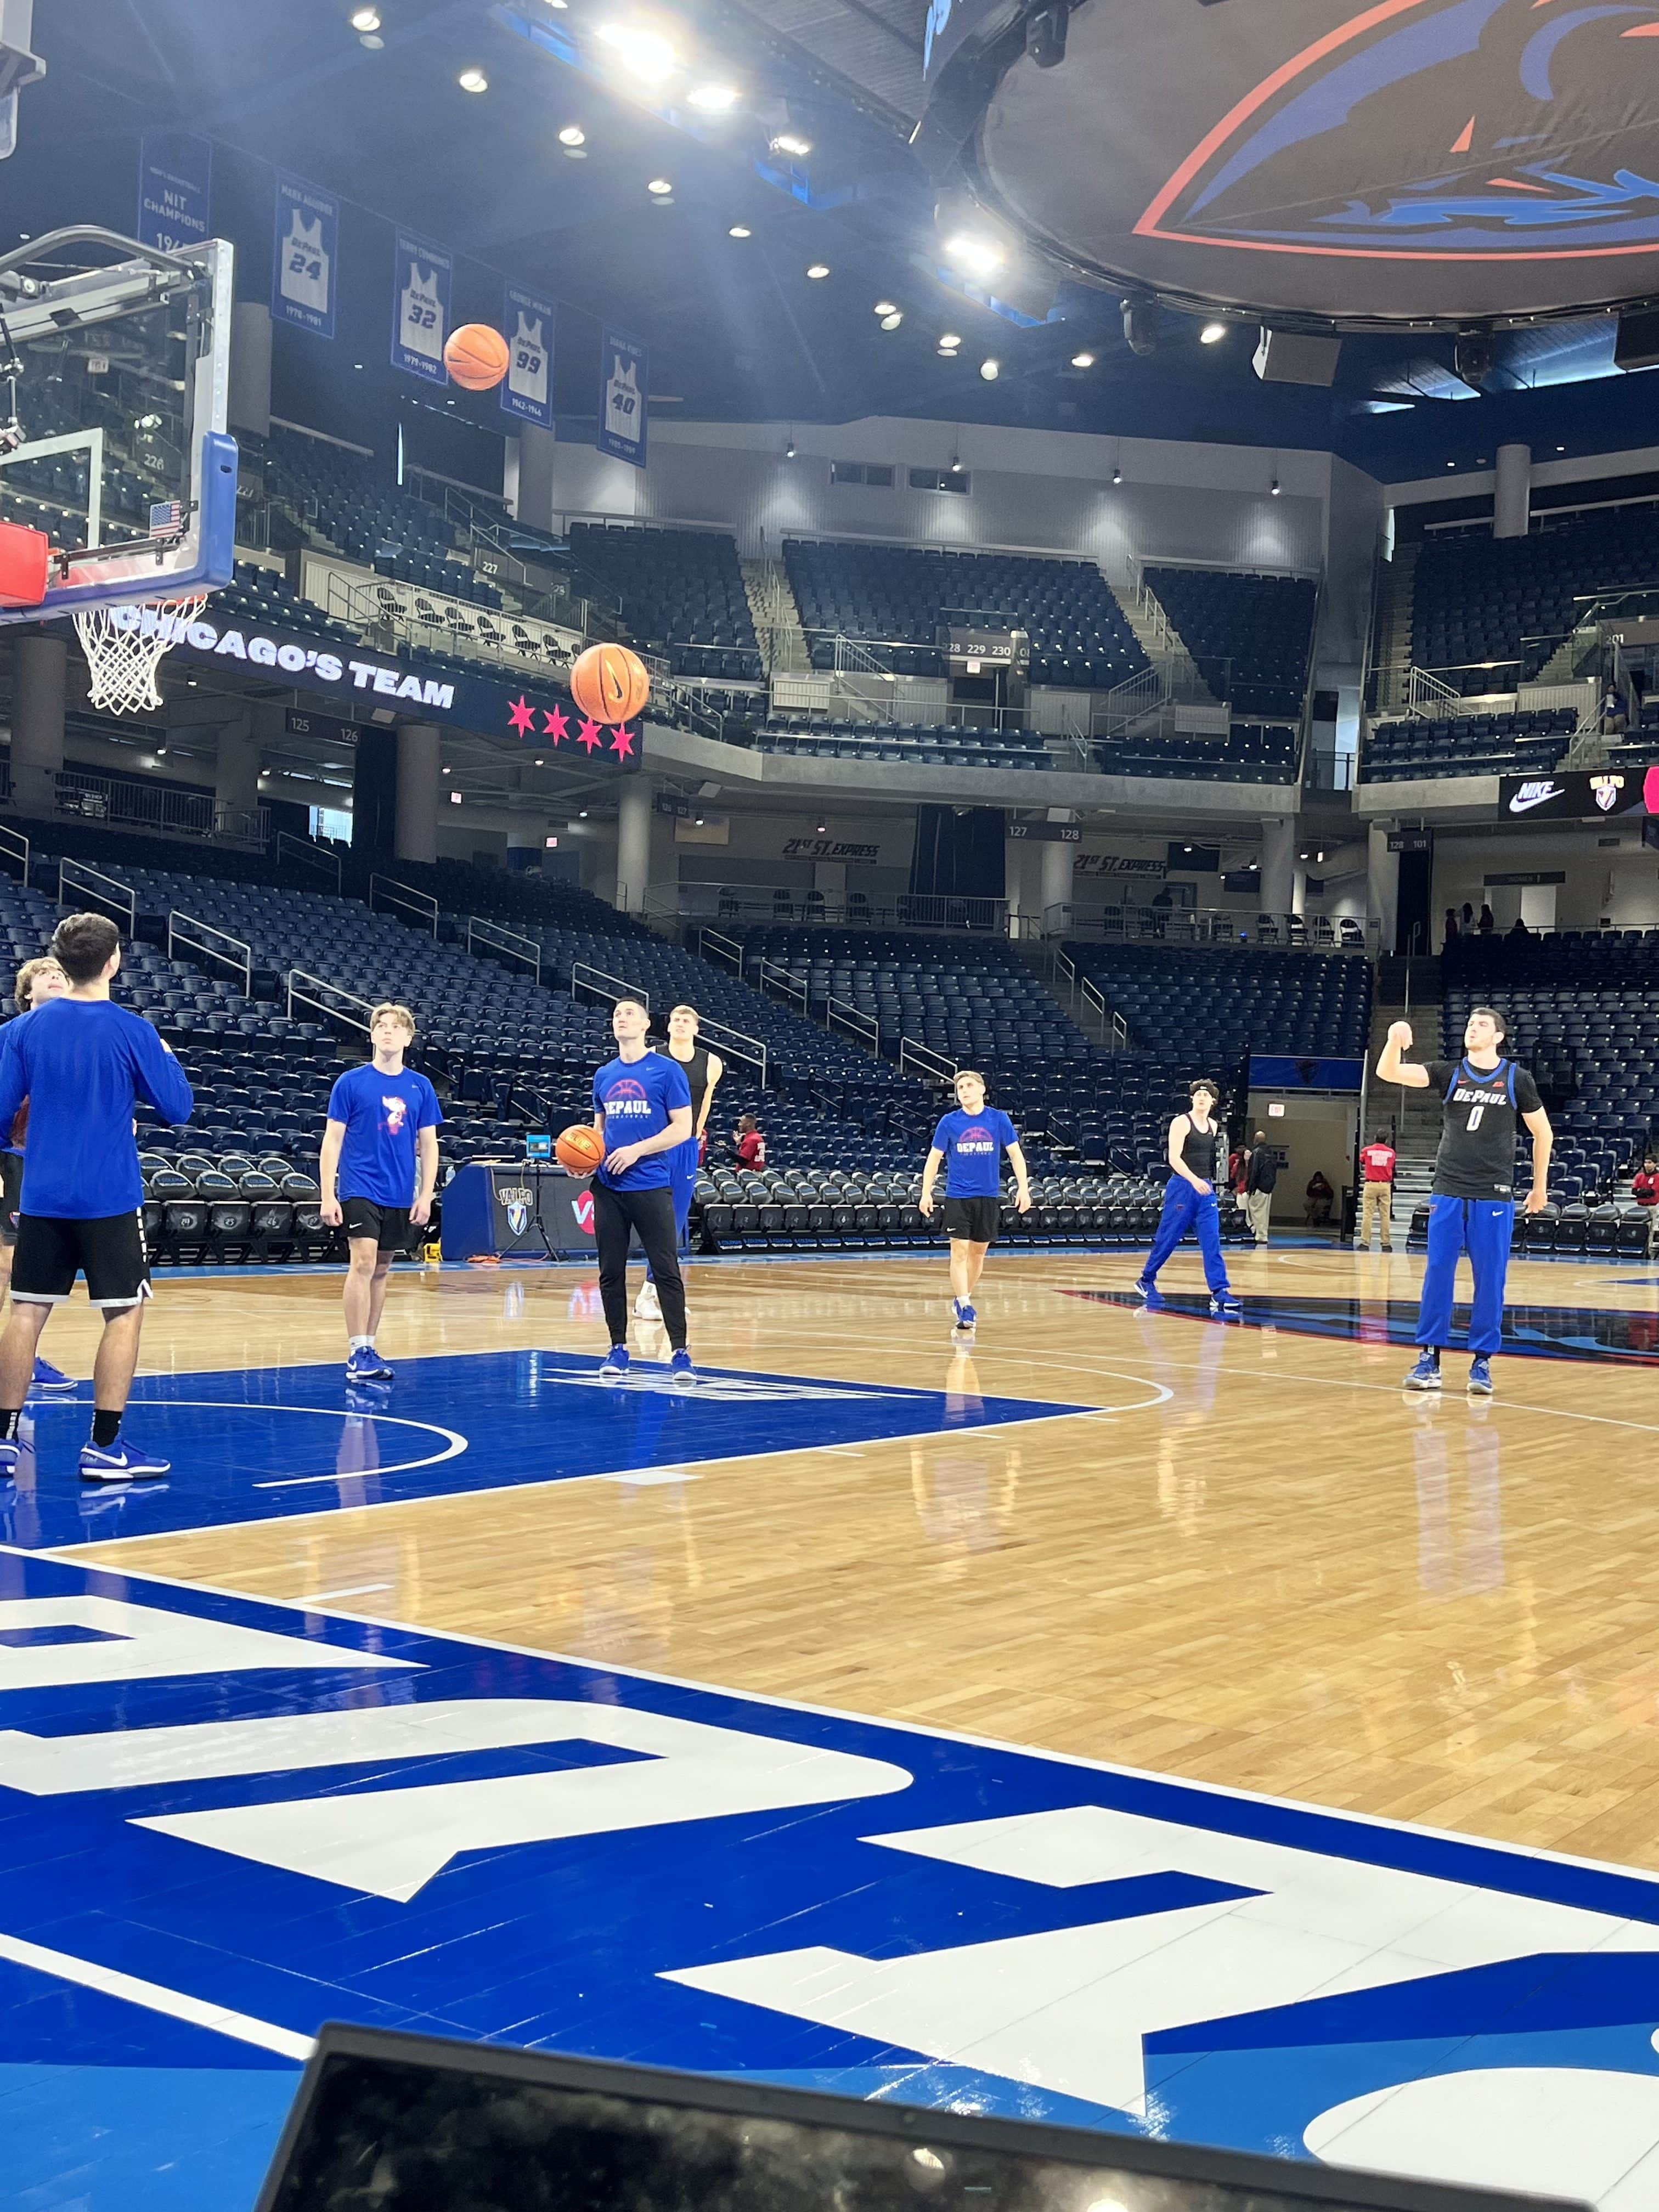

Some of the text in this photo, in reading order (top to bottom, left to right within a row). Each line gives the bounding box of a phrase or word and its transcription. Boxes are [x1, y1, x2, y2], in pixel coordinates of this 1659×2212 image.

[165, 189, 187, 210] NIT
[144, 198, 205, 233] CHAMPIONS
[289, 252, 321, 280] 24
[408, 304, 436, 329] 32
[403, 354, 437, 374] 1979-1982
[516, 351, 541, 374] 99
[512, 398, 542, 416] 1942-1946
[613, 393, 635, 415] 40
[483, 561, 498, 574] 227
[110, 605, 455, 709] CHICAGO'S TEAM
[967, 644, 986, 654] 229
[991, 646, 1011, 656] 230
[291, 718, 358, 742] 125 126
[1519, 781, 1555, 799] NIKE
[1009, 826, 1079, 840] 127 128
[1413, 840, 1426, 848] 101
[1466, 1105, 1485, 1131] 0
[956, 1142, 994, 1152] DEPAUL
